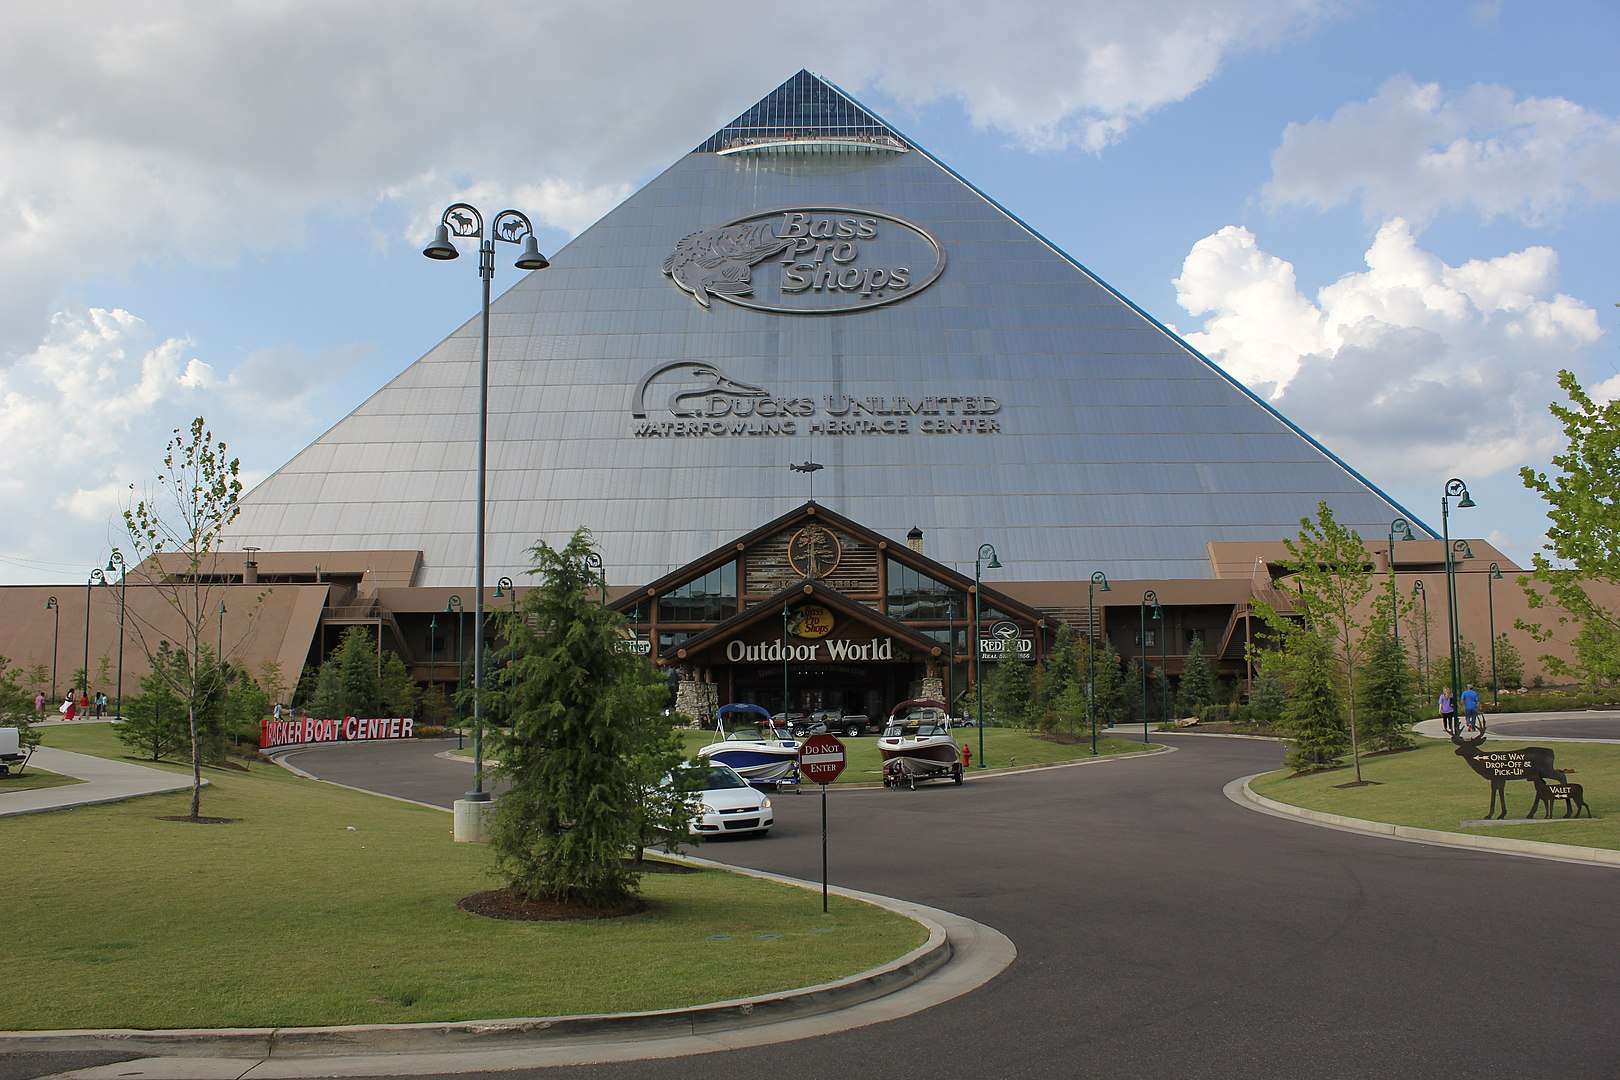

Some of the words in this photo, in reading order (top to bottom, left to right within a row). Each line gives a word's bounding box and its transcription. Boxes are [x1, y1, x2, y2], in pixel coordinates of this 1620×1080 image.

[775, 212, 878, 239] Bass
[780, 237, 859, 265] Pro
[780, 262, 912, 296] Shops
[705, 395, 816, 418] DUCKS
[823, 395, 1001, 417] UNLIMITED
[631, 420, 797, 438] WATERFOWLING
[808, 420, 909, 435] HERITAGE
[920, 419, 1001, 435] CENTER
[804, 623, 830, 635] Shops
[726, 639, 819, 662] Outdoor
[826, 637, 893, 661] World
[302, 717, 342, 742] BOAT
[343, 716, 414, 740] CENTER
[805, 745, 819, 755] DO
[821, 744, 839, 754] NOT
[811, 763, 836, 773] ENTER
[1550, 786, 1572, 794] VALET
